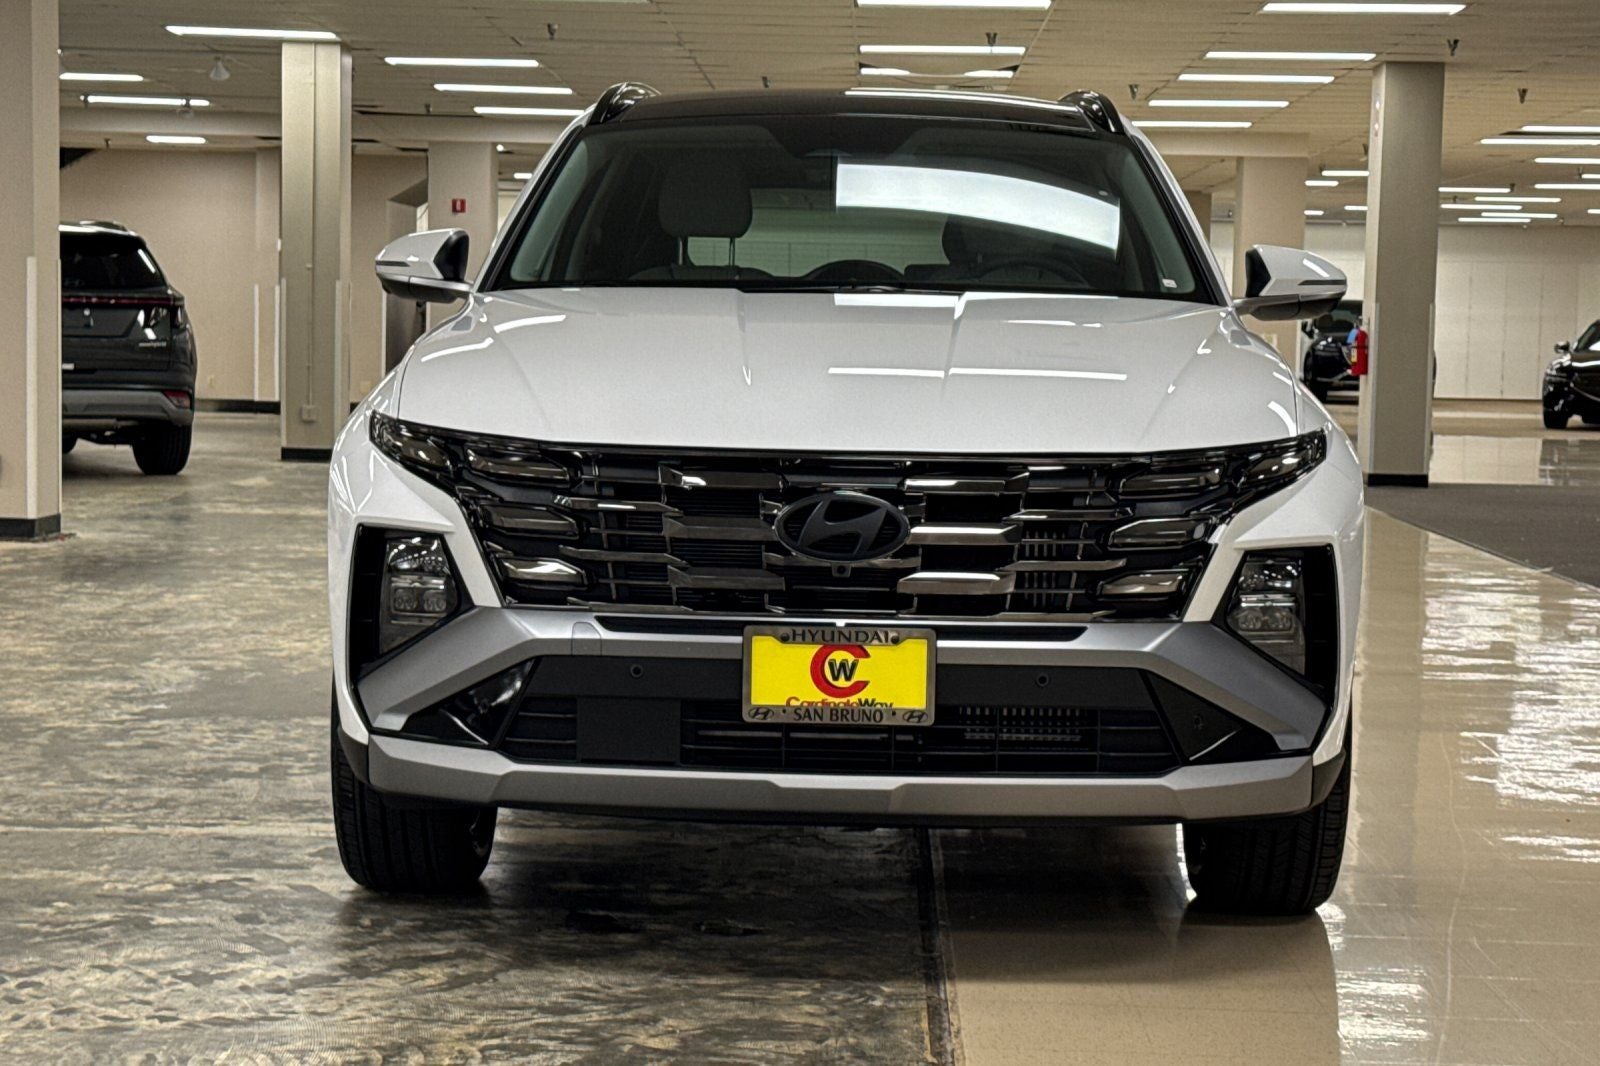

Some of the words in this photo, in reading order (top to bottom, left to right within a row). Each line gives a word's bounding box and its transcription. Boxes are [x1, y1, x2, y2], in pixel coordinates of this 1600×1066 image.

[792, 629, 889, 643] HYUNDAI
[794, 708, 824, 721] SAN
[829, 709, 884, 723] BRUNO
